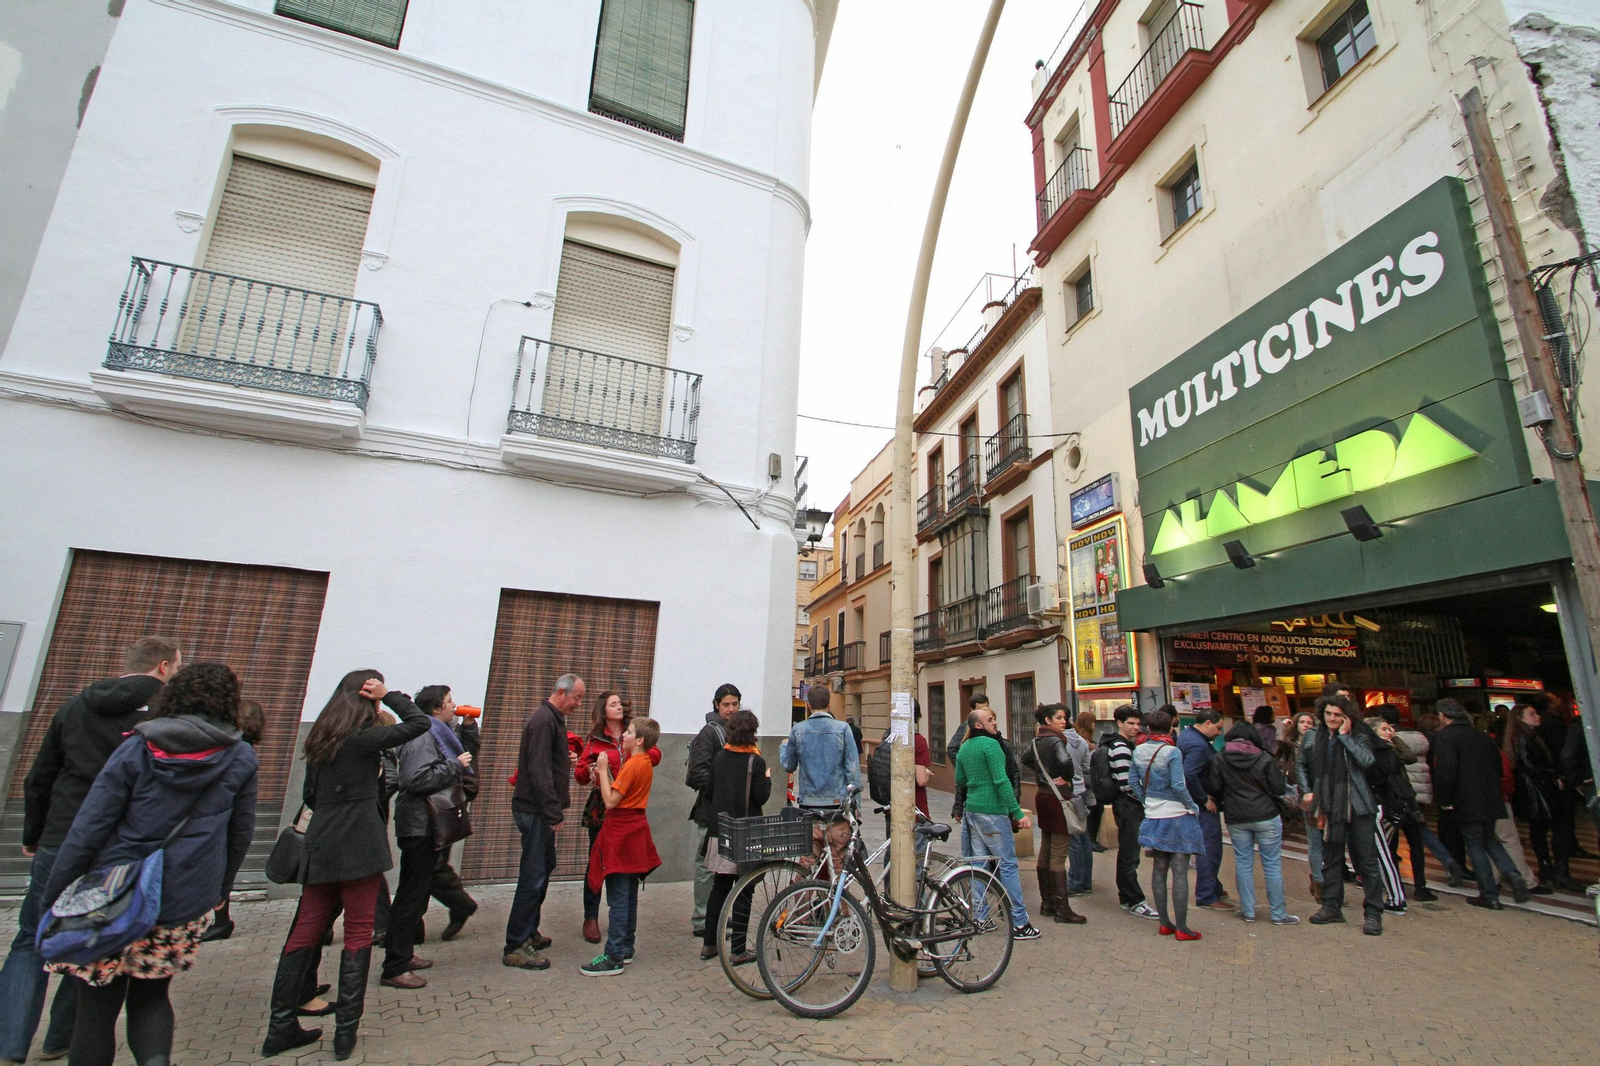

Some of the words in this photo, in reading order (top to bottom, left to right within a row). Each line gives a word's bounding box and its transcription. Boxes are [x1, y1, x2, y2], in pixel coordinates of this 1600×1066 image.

[1137, 231, 1444, 447] MULTICINES
[1151, 413, 1479, 555] ALAMEDA
[1071, 537, 1091, 550] HOY
[1093, 528, 1116, 542] HOY
[1075, 608, 1096, 619] HOY
[1100, 604, 1115, 614] HO
[1174, 640, 1249, 652] EXCLUSIVAMENTE
[1252, 644, 1262, 653] AL
[1264, 645, 1286, 654] OCIO
[1287, 646, 1292, 654] Y
[1211, 631, 1246, 642] CENTRO
[1247, 633, 1259, 643] EN
[1261, 635, 1307, 645] ANDALUCIA
[1308, 637, 1350, 647] DEDICADO
